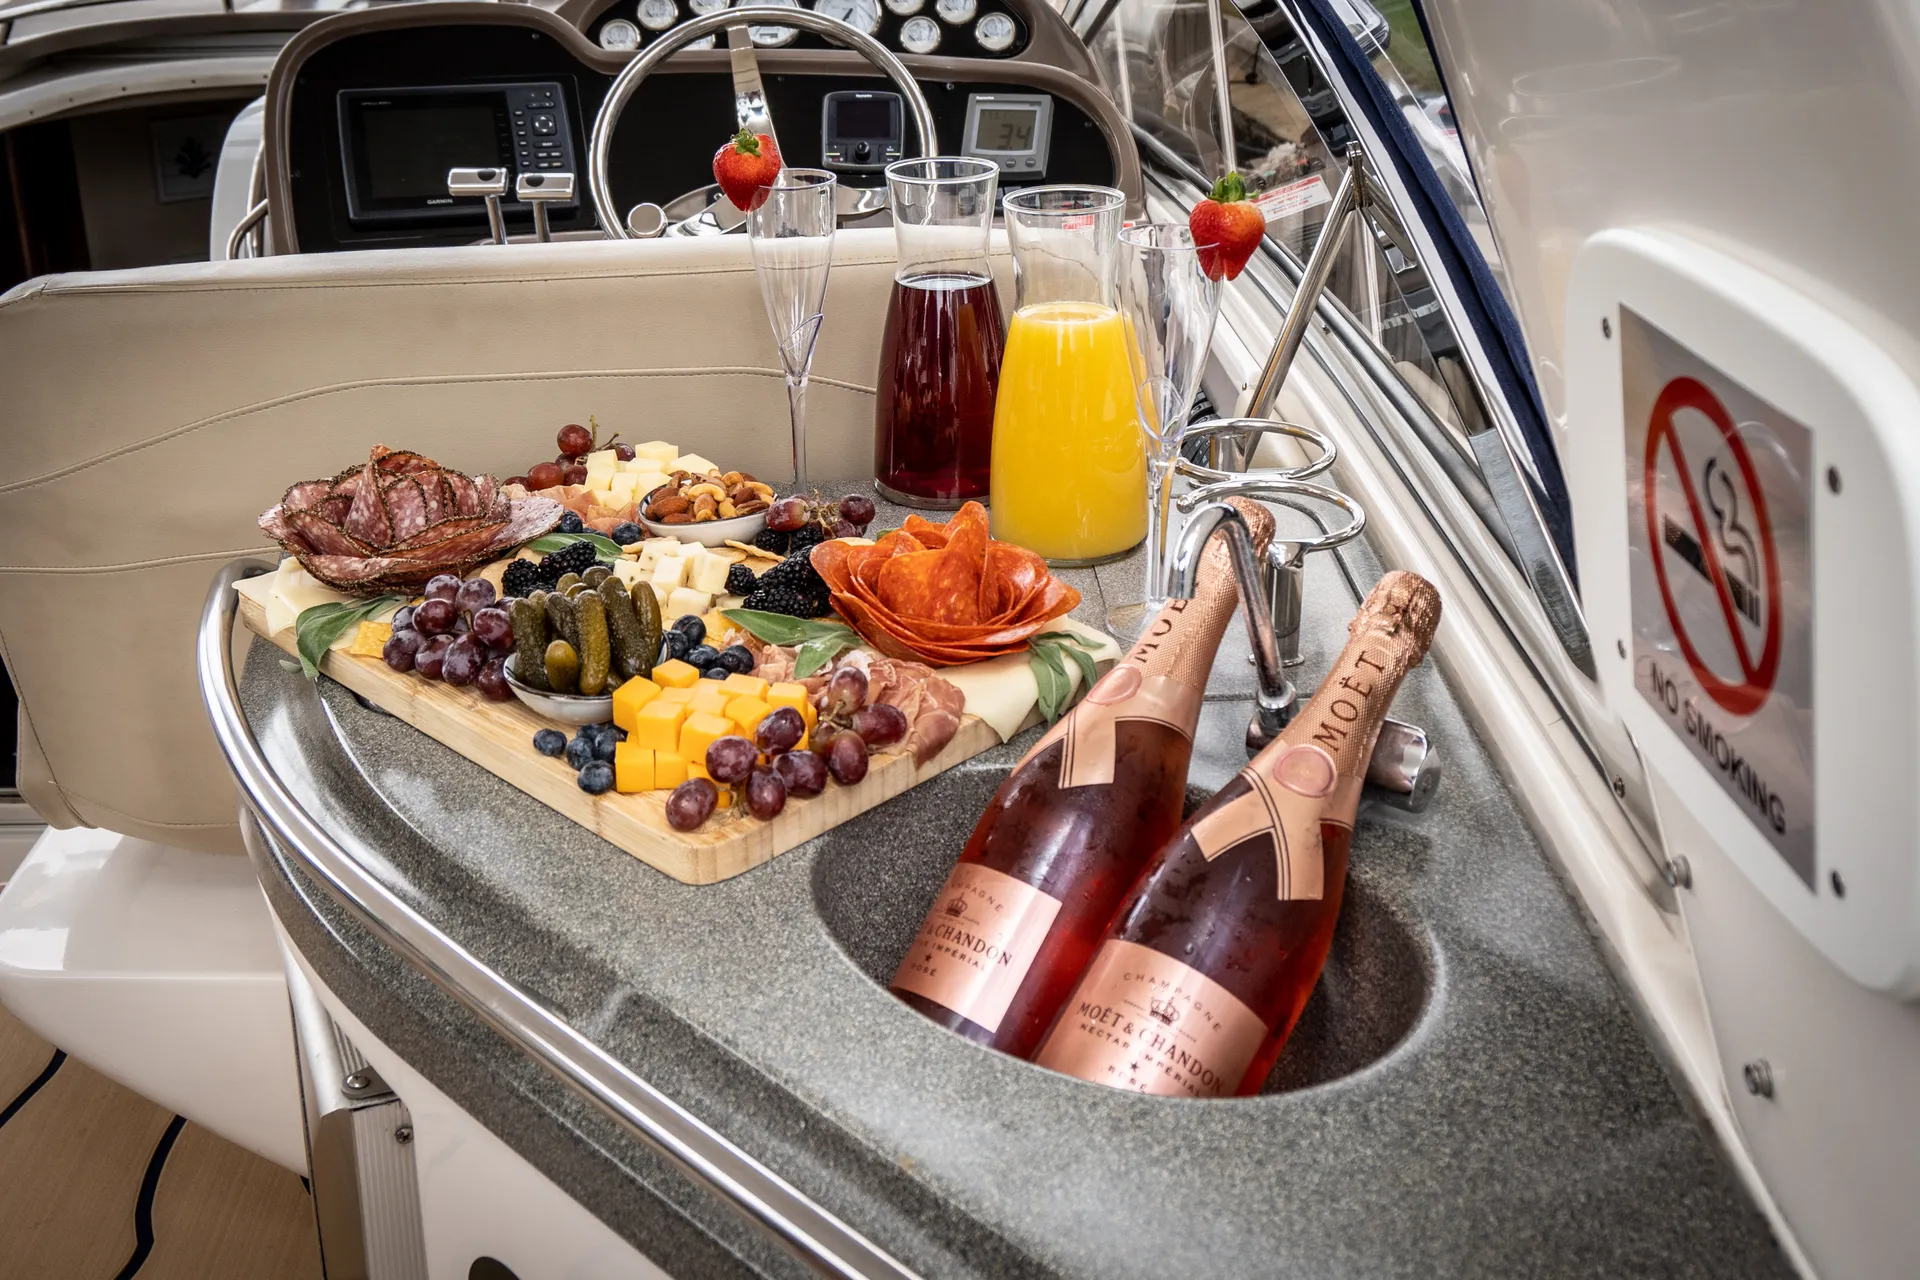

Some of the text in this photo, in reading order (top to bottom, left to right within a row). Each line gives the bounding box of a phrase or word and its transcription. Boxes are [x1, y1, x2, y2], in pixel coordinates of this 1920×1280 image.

[1651, 661, 1787, 836] NO SMOKING
[935, 923, 1013, 967] CHANDON
[1123, 972, 1222, 1033] CHAMPAGNE
[1078, 1001, 1124, 1028] MOËT
[1123, 1022, 1134, 1035] &
[1139, 1028, 1226, 1096] CHANDON
[1080, 1023, 1130, 1050] NECTAR
